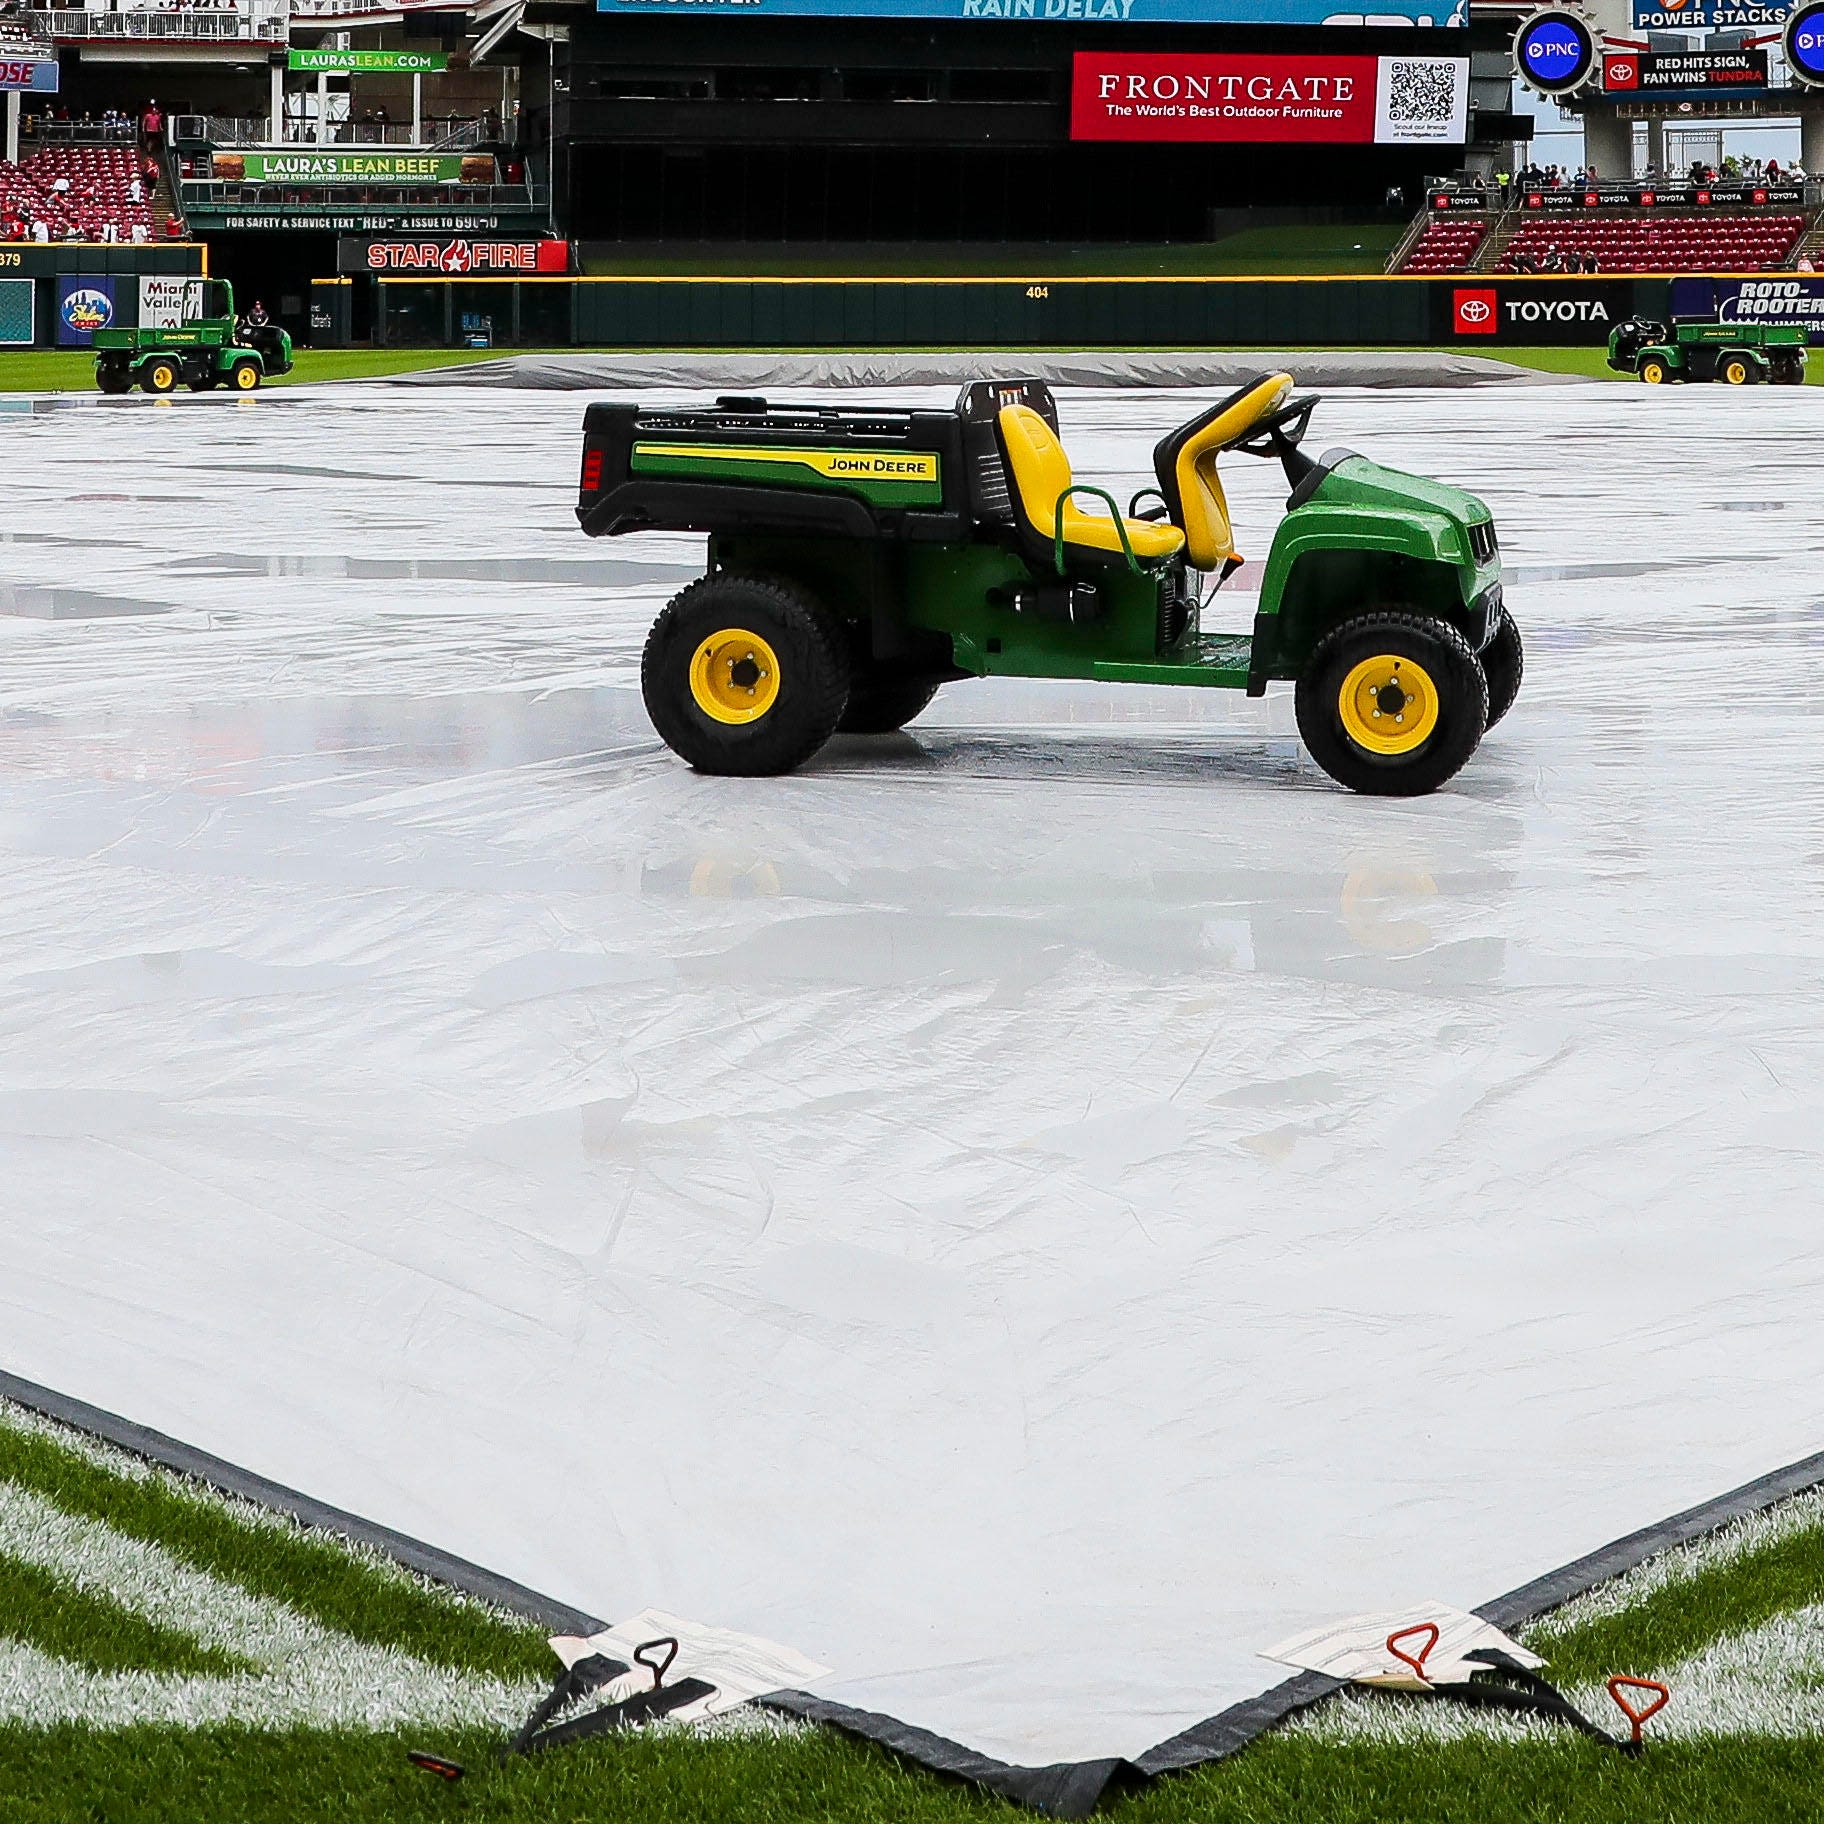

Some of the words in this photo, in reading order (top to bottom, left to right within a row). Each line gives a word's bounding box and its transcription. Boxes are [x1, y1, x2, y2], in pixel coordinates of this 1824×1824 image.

[1639, 10, 1705, 26] POWER
[1712, 7, 1786, 24] STACKS
[1546, 42, 1579, 56] PNC
[300, 52, 432, 69] LAURASLEAN.COM
[1656, 57, 1681, 70] RED
[1684, 57, 1710, 68] HITS
[1713, 55, 1750, 70] SIGN,
[1644, 72, 1669, 84] FAN
[1672, 71, 1706, 83] WINS
[1708, 69, 1762, 83] TUNDRA
[1099, 75, 1353, 101] FRONTGATE
[1107, 105, 1132, 116] The
[1136, 105, 1186, 116] World's
[1190, 105, 1220, 117] Best
[1223, 105, 1279, 118] Outdoor
[1283, 106, 1342, 118] Furniture
[263, 158, 337, 174] LAURA'S
[342, 159, 389, 174] LEAN
[395, 159, 439, 173] BEEF
[227, 218, 244, 227] FOR
[246, 218, 279, 228] SAFETY
[292, 218, 330, 228] SERVICE
[333, 218, 354, 228] TEXT
[412, 218, 438, 227] ISSUE
[441, 218, 453, 227] TO
[368, 244, 439, 267] STAR
[472, 244, 536, 267] FIRE
[1026, 287, 1048, 298] 404
[1740, 283, 1809, 298] ROTO-
[1506, 302, 1609, 320] TOYOTA
[828, 458, 870, 470] JOHN
[874, 460, 926, 473] DEERE
